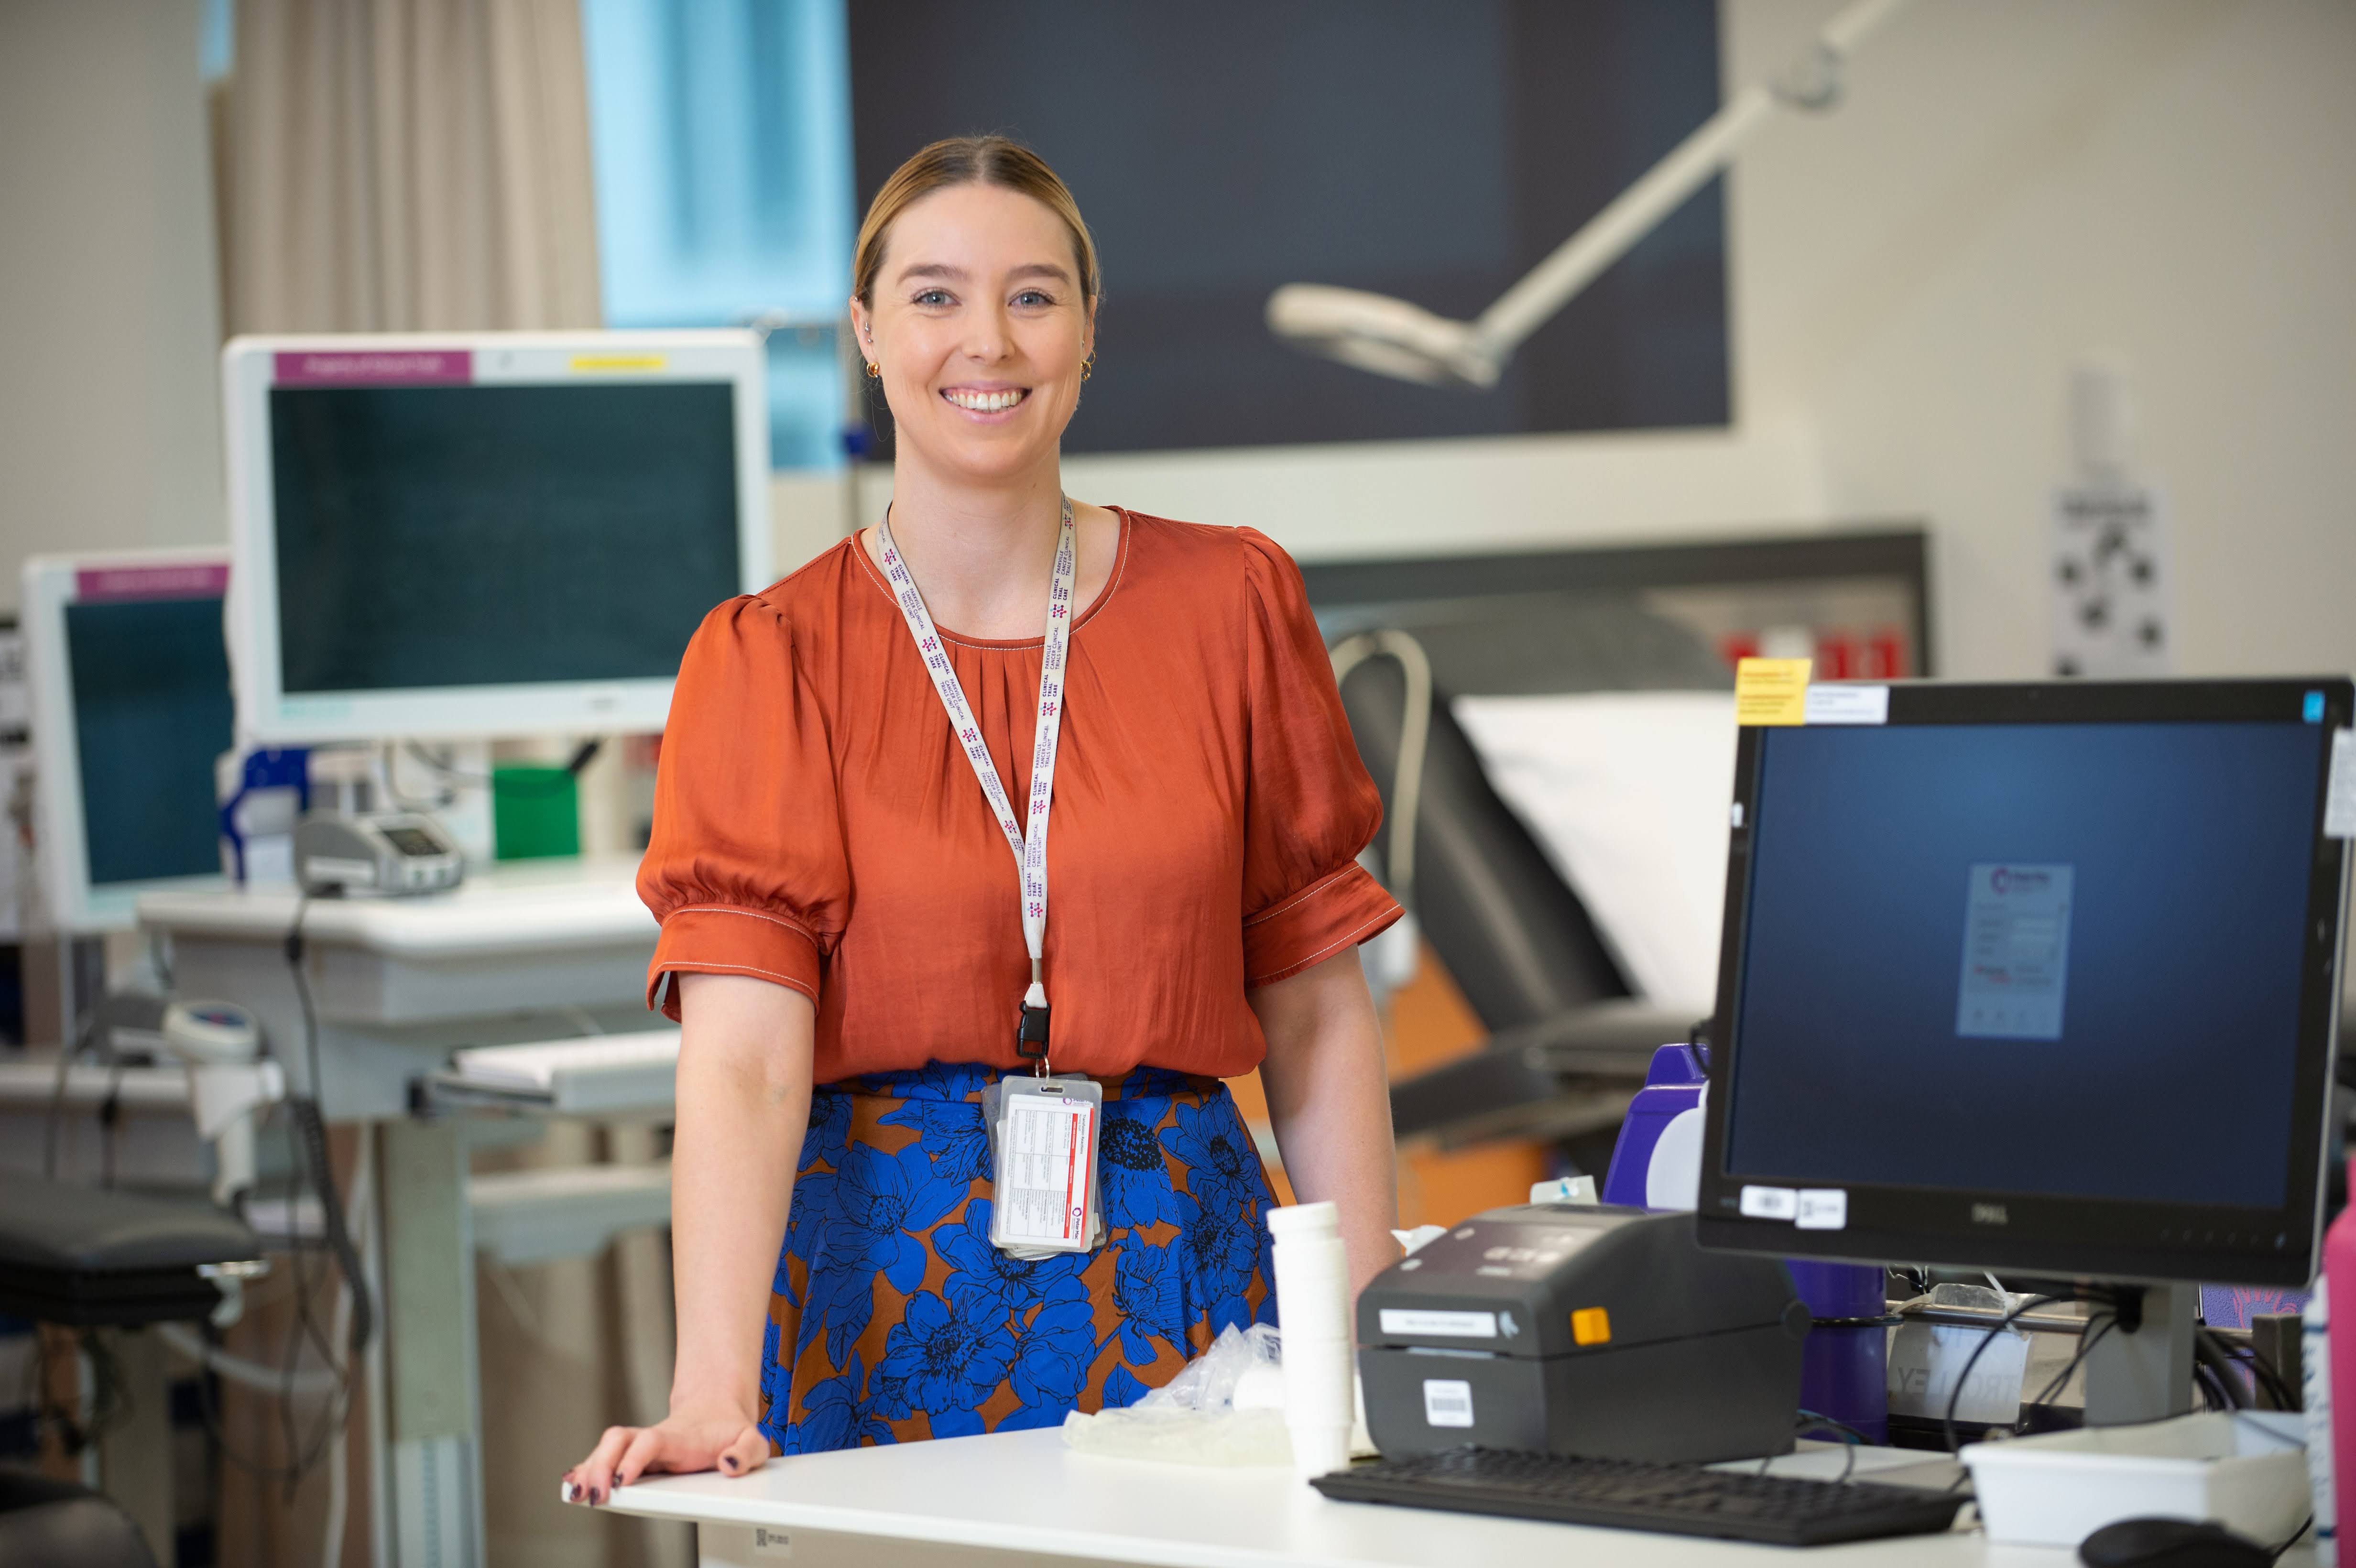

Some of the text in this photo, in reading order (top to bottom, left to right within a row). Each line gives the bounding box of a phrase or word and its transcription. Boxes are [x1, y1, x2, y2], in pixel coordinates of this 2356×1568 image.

[898, 565, 909, 585] CLINICAL
[901, 593, 909, 608] TRIALS
[910, 588, 922, 610] PARKVILLE
[905, 591, 925, 630] CANCER CLINICAL
[939, 653, 950, 675] CLINICAL
[940, 682, 949, 697] TRIALS
[945, 681, 965, 720] CANCER CLINICAL
[950, 678, 962, 702] PARKVILLE
[979, 745, 990, 767] CLINICAL
[981, 773, 990, 787] TRIALS
[990, 772, 1002, 794] PARKVILLE
[985, 772, 1005, 812] CANCER CLINICAL
